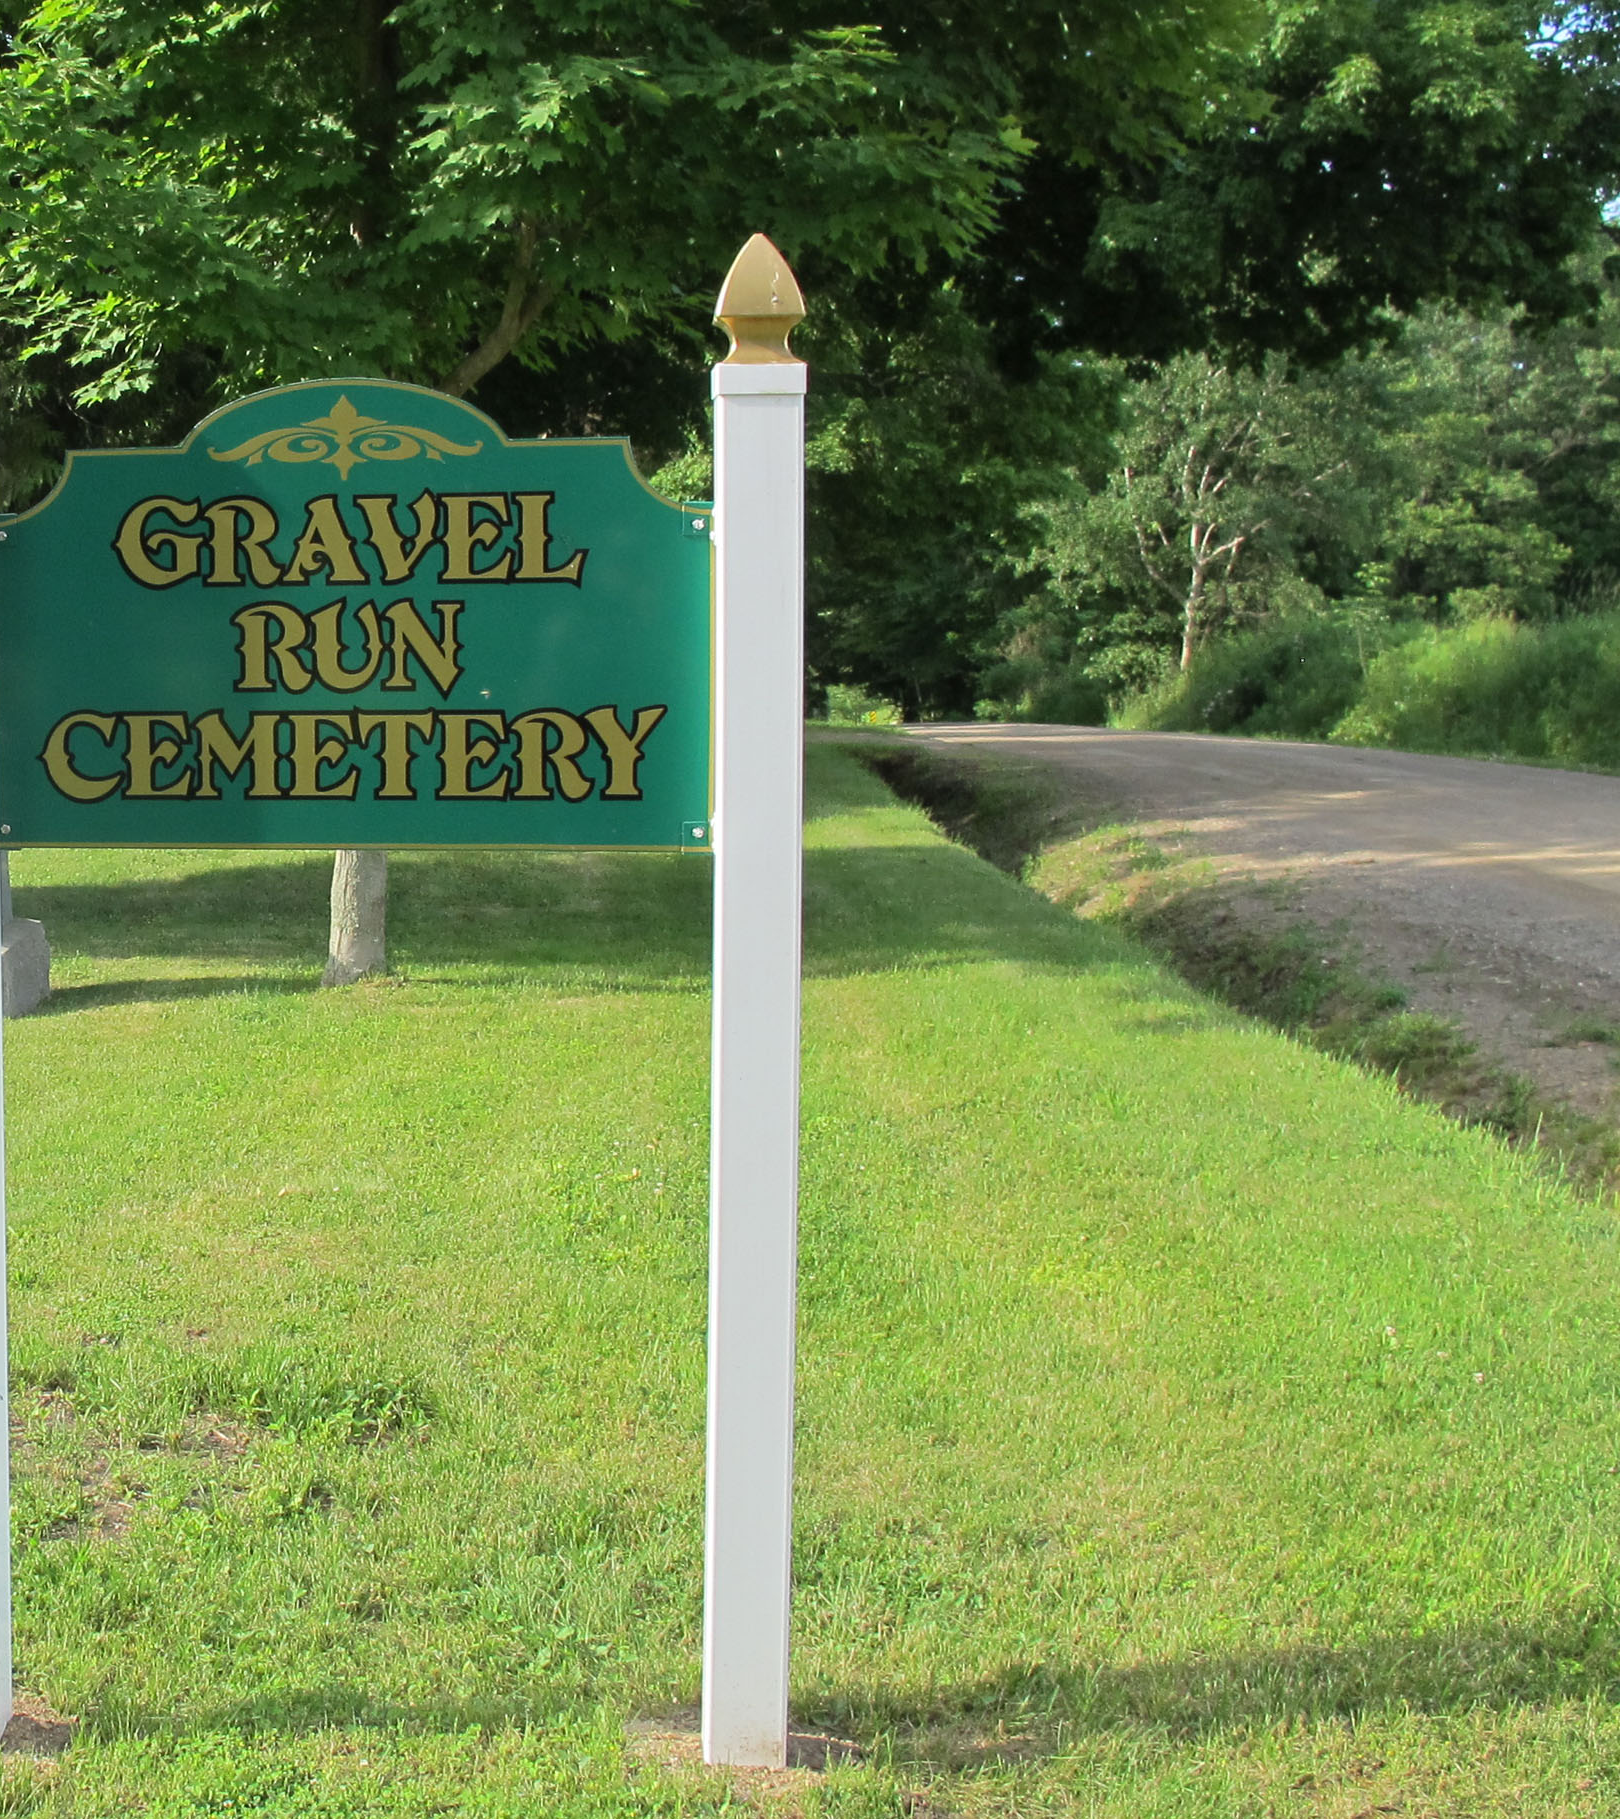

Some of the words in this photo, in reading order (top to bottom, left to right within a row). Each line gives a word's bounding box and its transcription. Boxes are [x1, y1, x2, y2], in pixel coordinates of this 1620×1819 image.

[110, 488, 589, 591] GRAVEL
[229, 596, 466, 701] RUN
[36, 704, 668, 804] CEMETERY
